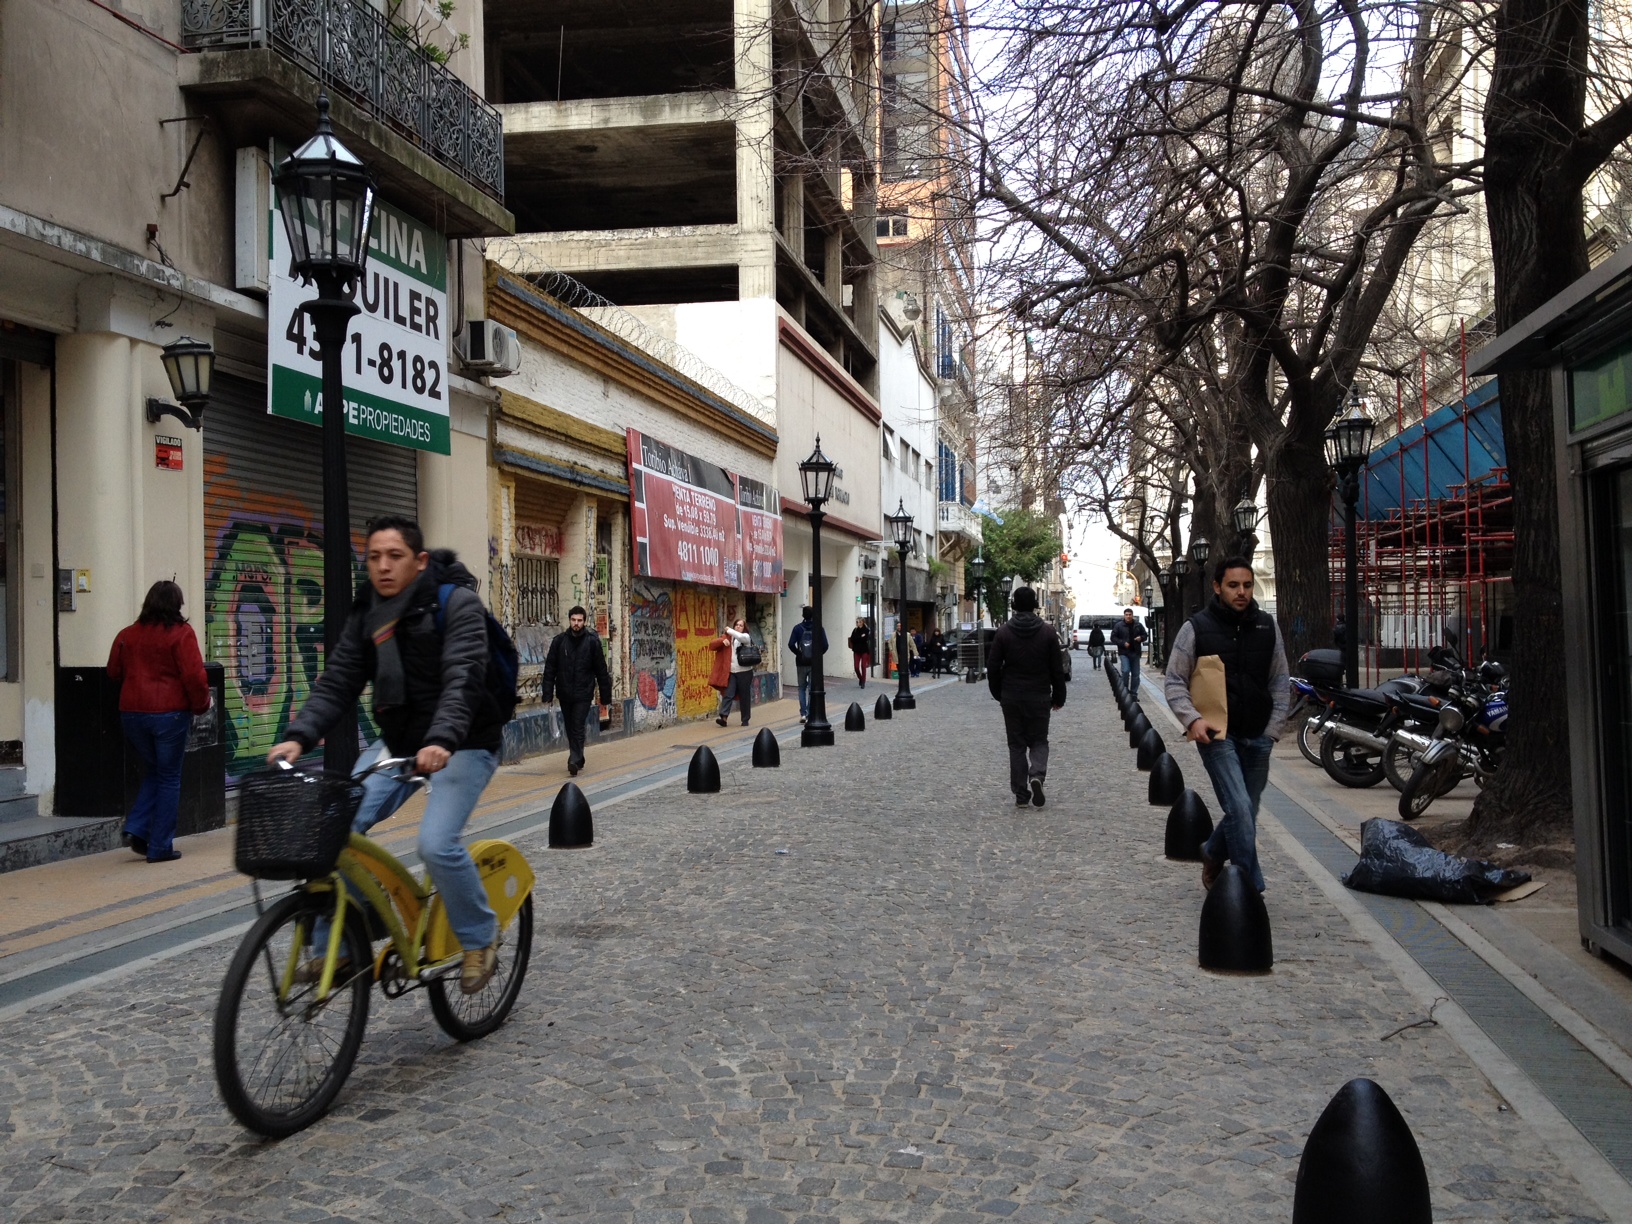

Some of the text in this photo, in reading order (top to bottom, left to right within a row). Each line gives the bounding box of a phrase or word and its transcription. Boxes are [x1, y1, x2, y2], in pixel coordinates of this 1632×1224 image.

[286, 307, 442, 401] 431-8182
[313, 392, 431, 443] APE PROPIEDADES
[156, 436, 181, 447] VIGILADO
[672, 483, 716, 512] VENTA TERRENO
[676, 503, 684, 516] de
[663, 513, 677, 531] Sup.
[678, 540, 719, 567] 4811 1000
[1487, 704, 1509, 717] YAMAH
